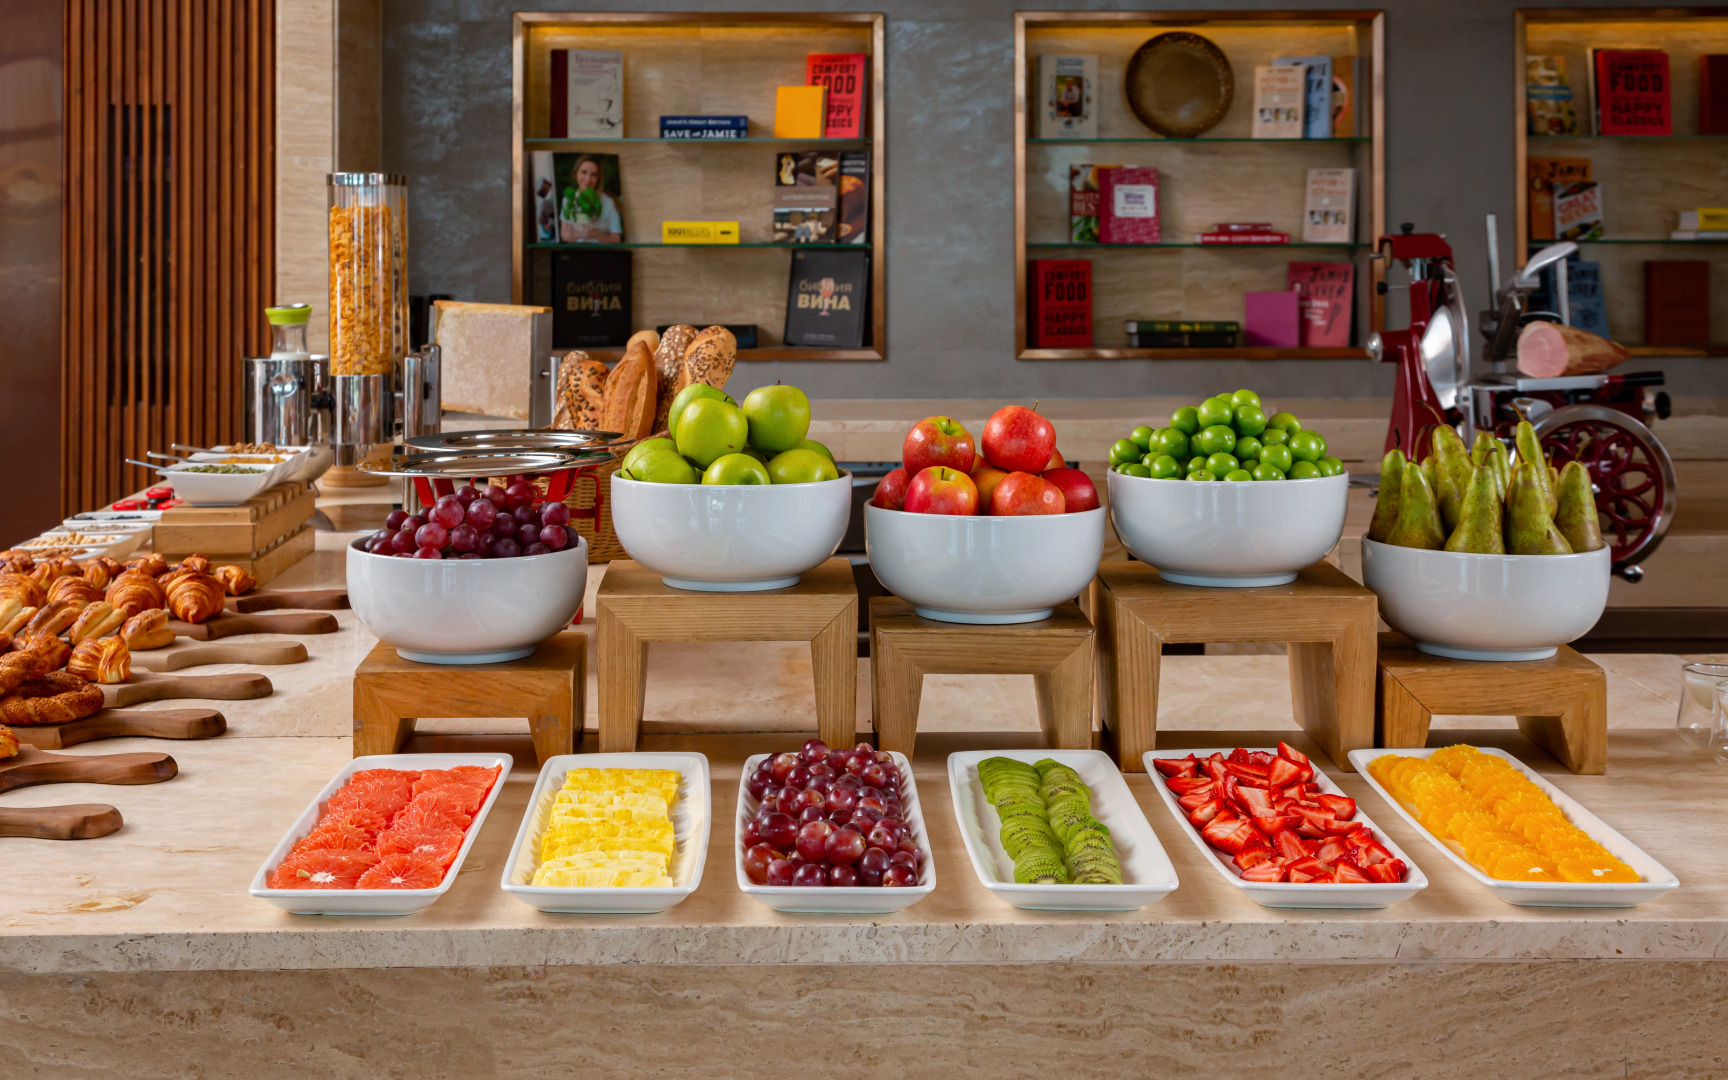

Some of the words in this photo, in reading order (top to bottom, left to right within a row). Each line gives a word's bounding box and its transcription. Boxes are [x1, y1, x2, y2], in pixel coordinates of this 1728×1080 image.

[812, 64, 857, 74] COMFORT
[1610, 62, 1662, 72] COMFORT
[811, 75, 856, 94] FOOD
[1610, 74, 1663, 92] FOOD
[828, 104, 854, 116] PPY
[1611, 103, 1663, 113] HAPPY
[1611, 116, 1664, 126] CLASSICS
[664, 129, 691, 138] SAVE
[702, 129, 737, 138] JAMIE
[1549, 162, 1588, 178] JAMIE
[1558, 189, 1596, 213] GREAT
[1045, 271, 1086, 281] COMFORT
[1310, 267, 1349, 283] JAMIE
[1045, 282, 1087, 301] FOOD
[567, 296, 622, 311] ВИНА
[797, 293, 851, 311] ВИНА
[1045, 312, 1087, 324] HAPPY
[1045, 325, 1087, 336] CLASSICS
